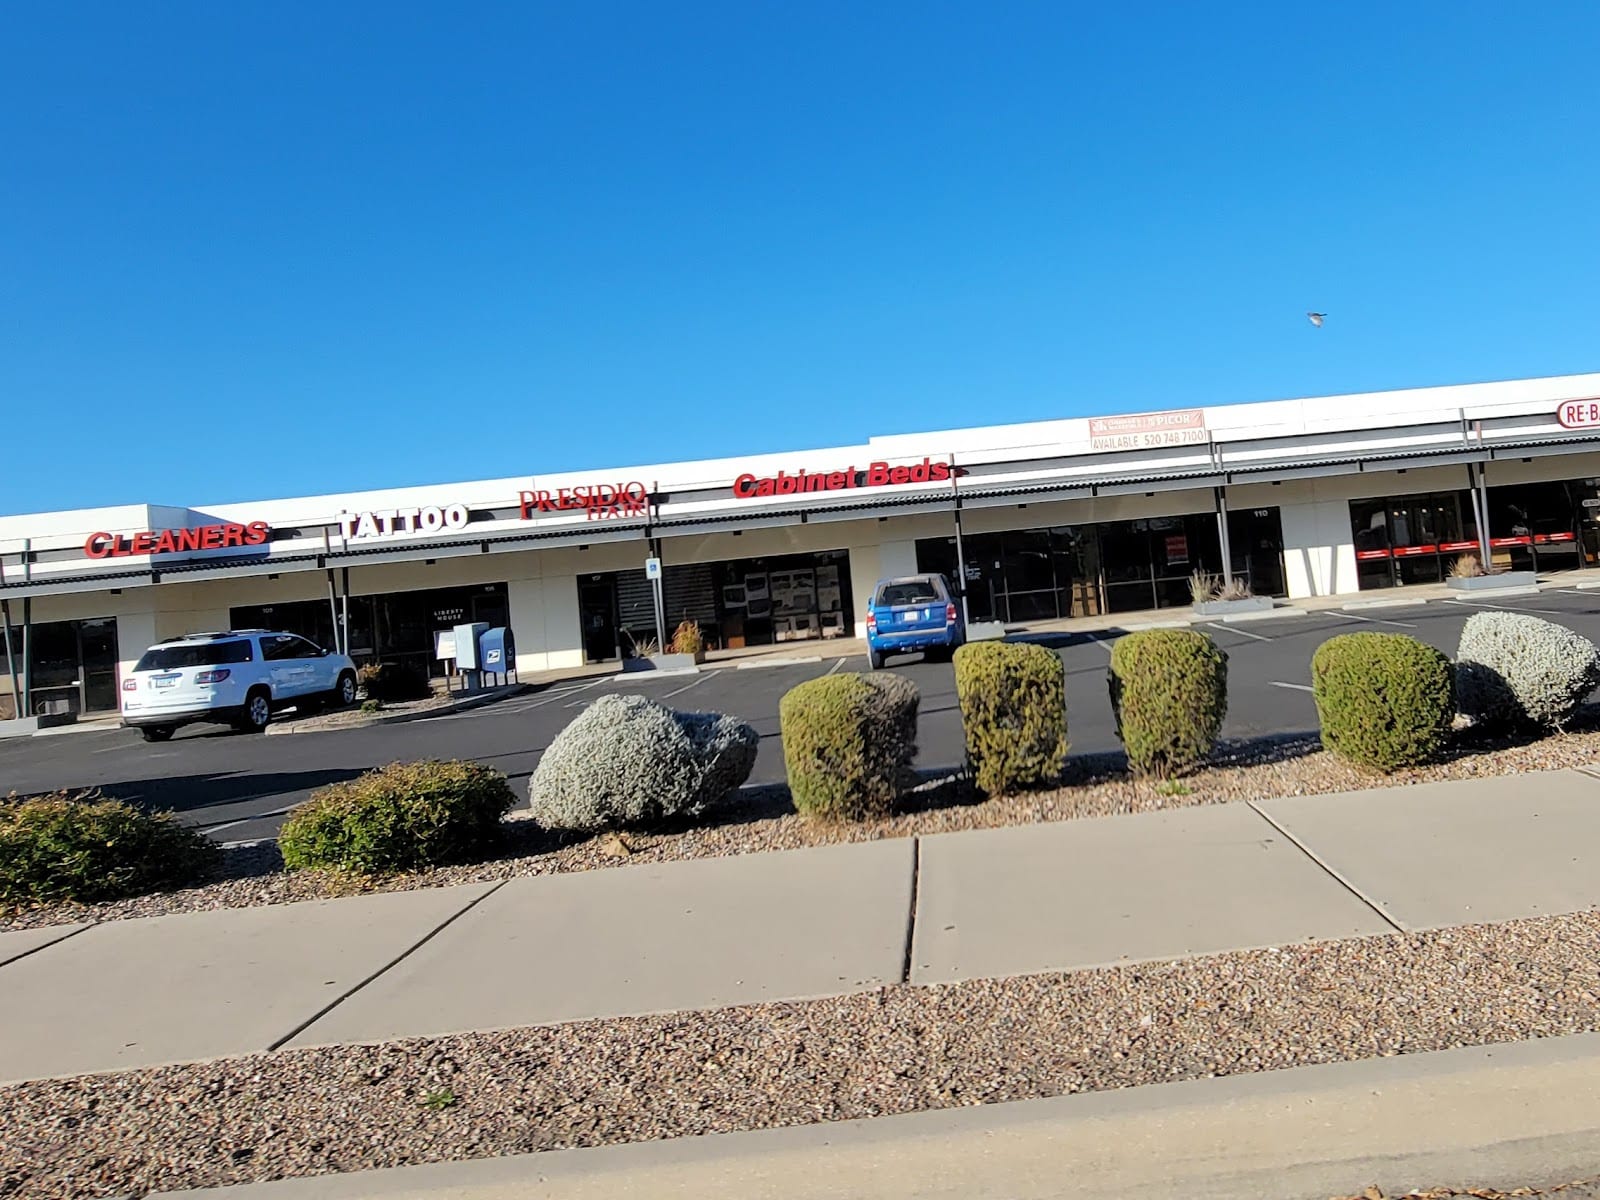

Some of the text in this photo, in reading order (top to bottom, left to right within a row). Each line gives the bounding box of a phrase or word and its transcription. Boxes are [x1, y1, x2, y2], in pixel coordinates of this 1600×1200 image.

[1158, 414, 1191, 426] PICOR
[1093, 430, 1204, 449] AVAILABLE 520 748 7100
[733, 457, 952, 498] Cabinet Beds
[518, 481, 647, 520] PRESIDIO
[586, 502, 648, 520] HAIR
[1254, 510, 1268, 518] 110
[335, 503, 469, 540] TATTOO
[83, 521, 270, 559] CLEANERS
